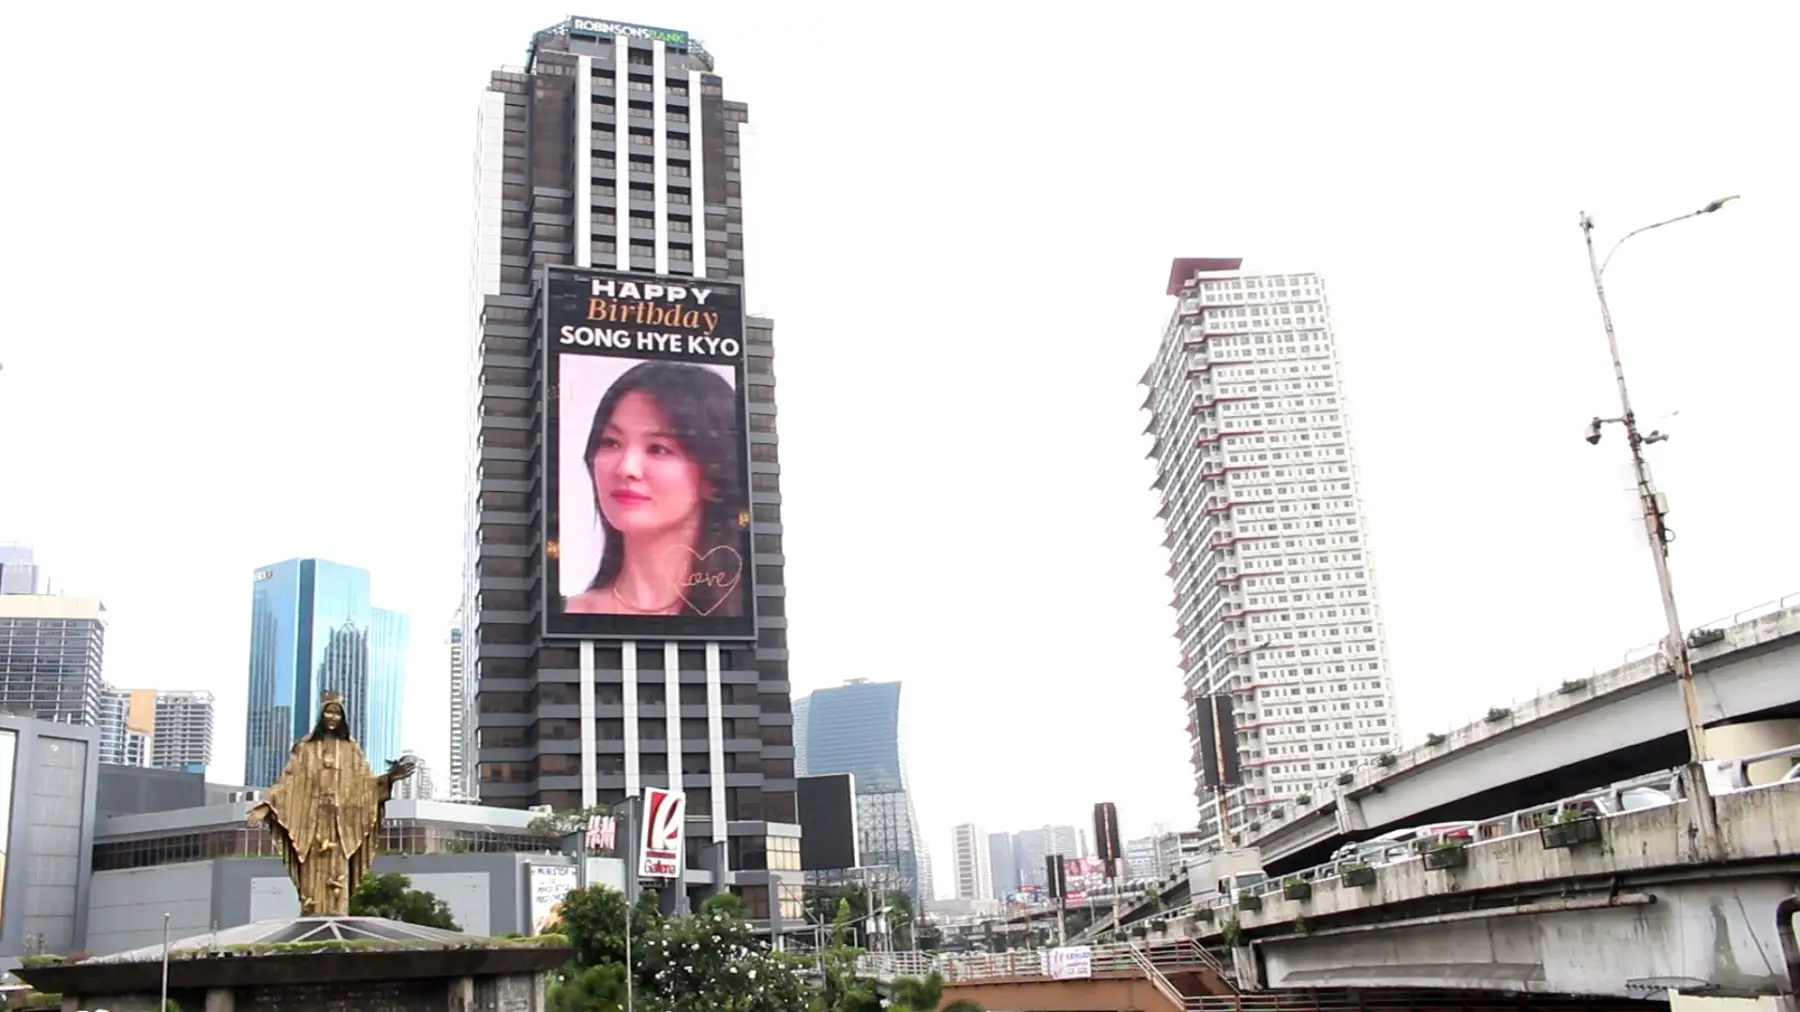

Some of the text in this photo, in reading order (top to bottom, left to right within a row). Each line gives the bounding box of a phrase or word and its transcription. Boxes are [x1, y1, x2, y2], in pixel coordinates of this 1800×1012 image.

[591, 279, 712, 305] HAPPY
[587, 297, 718, 335] Birthday
[559, 325, 740, 357] SONG HYE KYO
